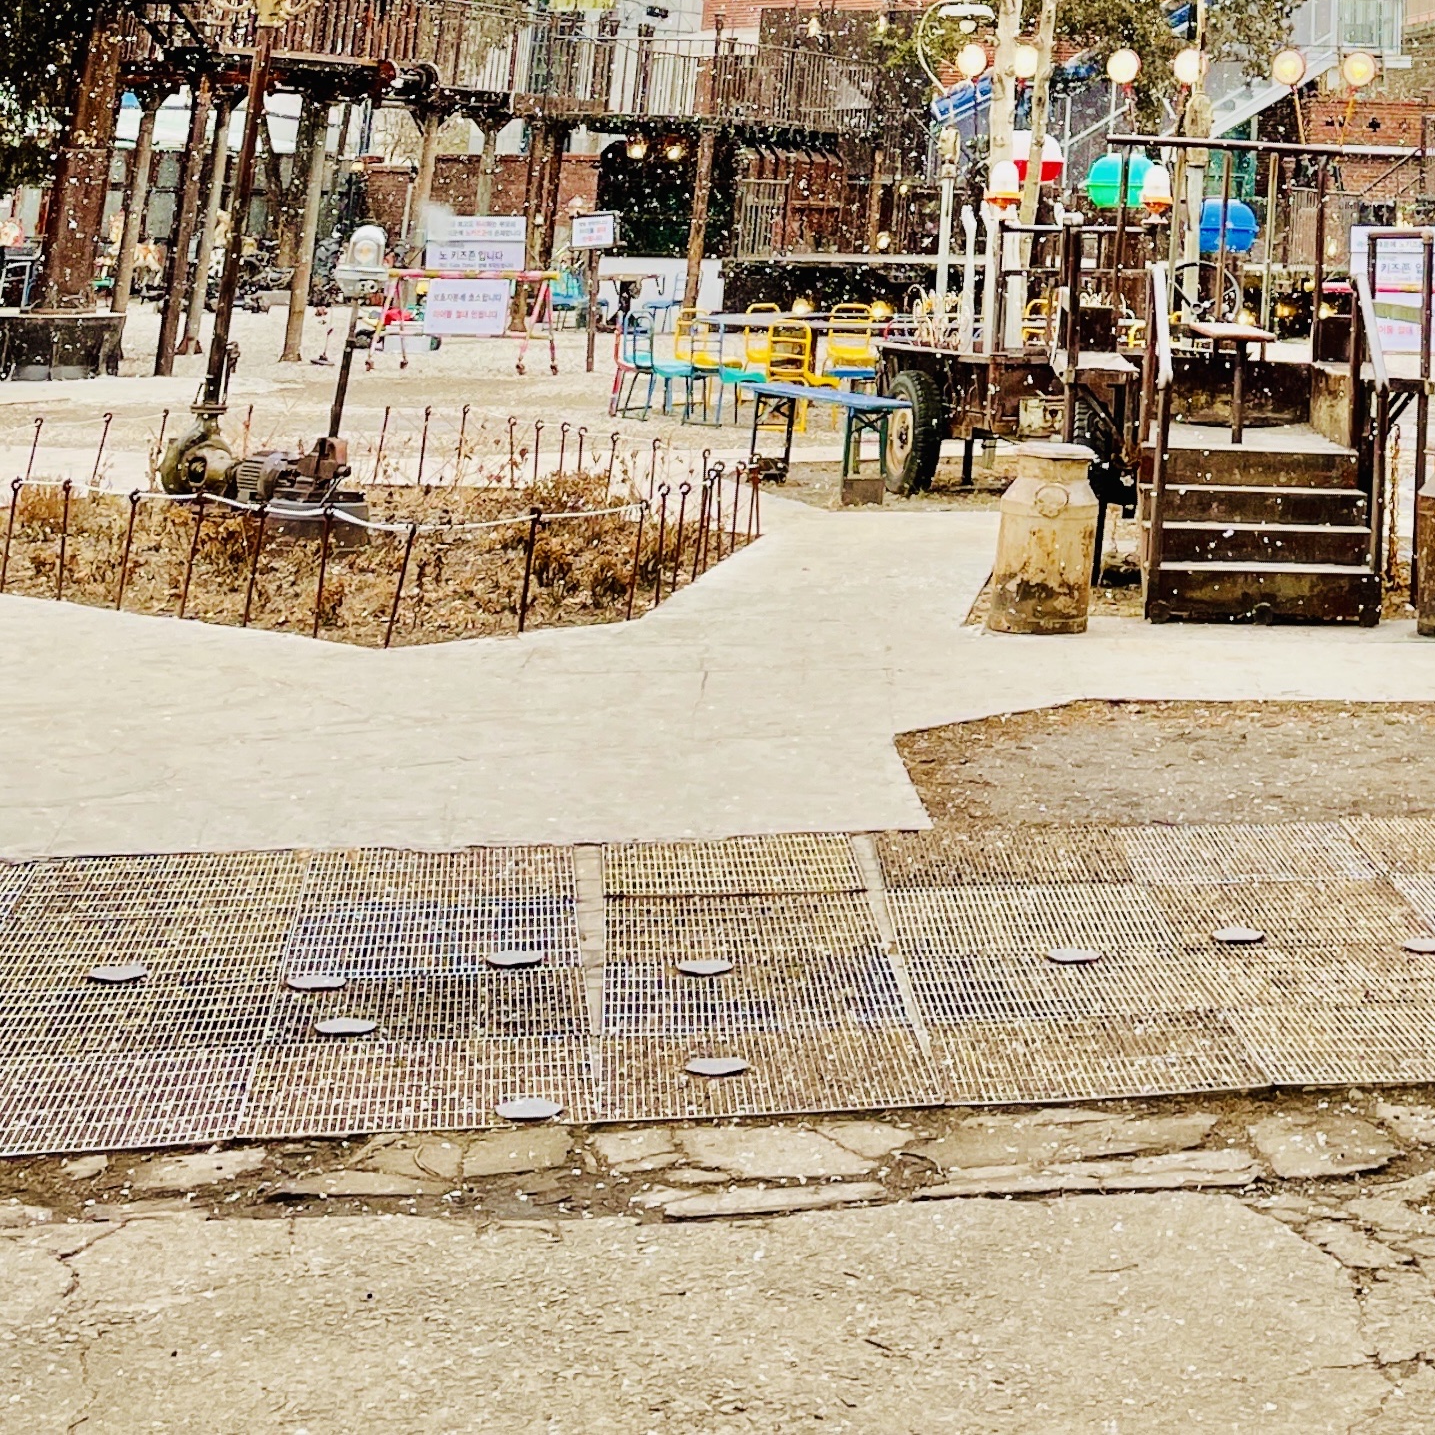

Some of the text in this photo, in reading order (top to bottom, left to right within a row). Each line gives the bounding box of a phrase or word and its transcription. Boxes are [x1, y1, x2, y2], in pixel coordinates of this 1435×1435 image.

[439, 251, 504, 262] 노 키즈존 입니다
